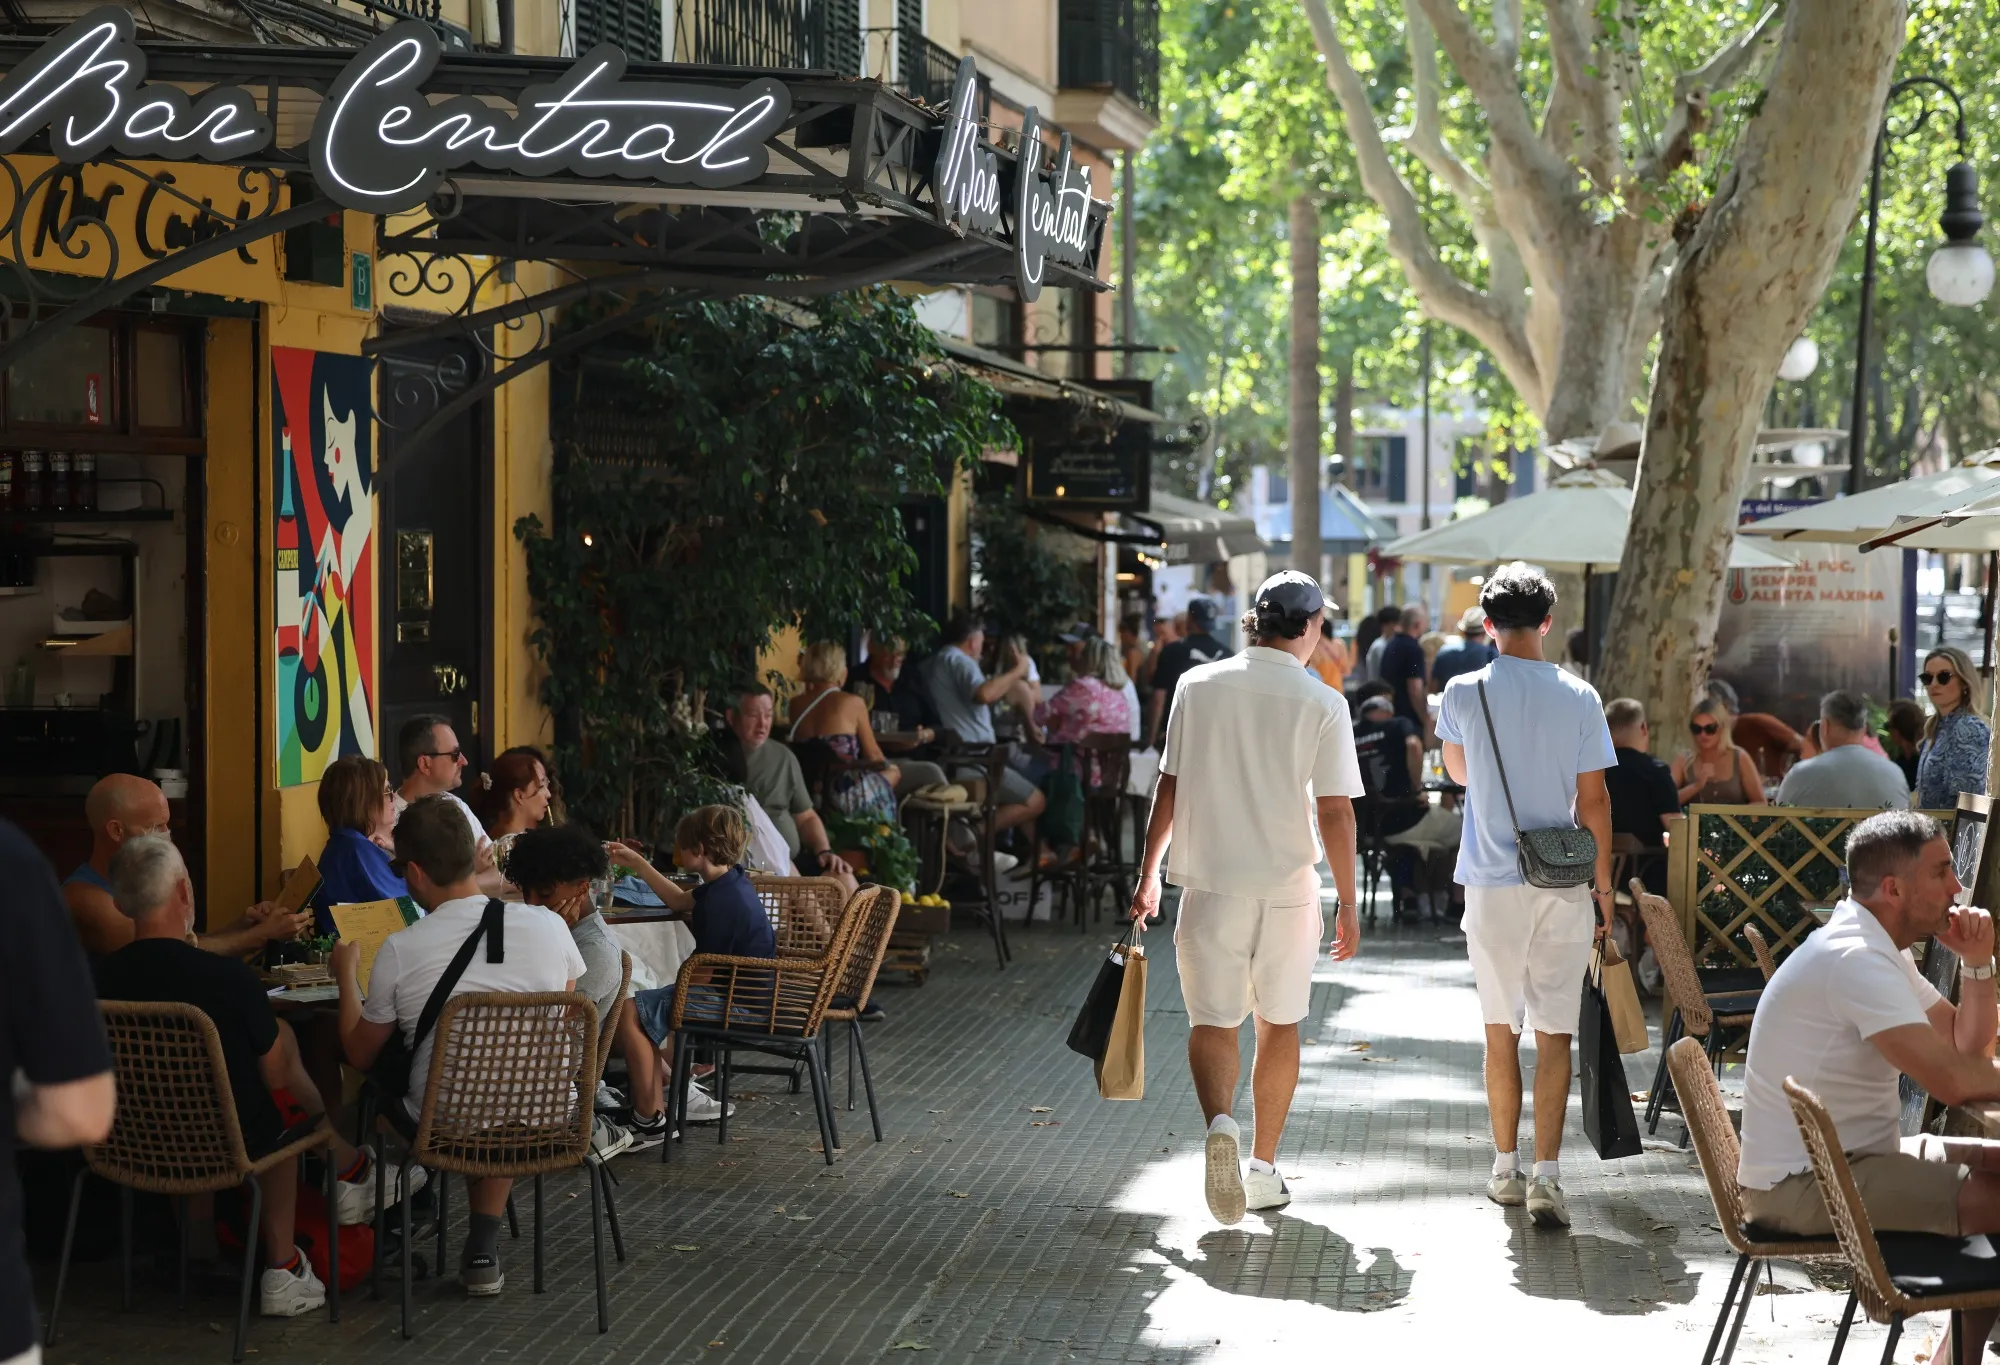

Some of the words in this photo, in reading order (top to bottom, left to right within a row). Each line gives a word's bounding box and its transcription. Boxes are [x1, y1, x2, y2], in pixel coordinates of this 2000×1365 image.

[0, 21, 255, 147] Bar
[325, 37, 775, 196] Central
[943, 77, 999, 216] Bar
[1022, 124, 1093, 284] Central
[278, 549, 299, 569] CAMPARI
[1751, 575, 1817, 586] SEMPRE
[1752, 590, 1814, 600] ALERTA
